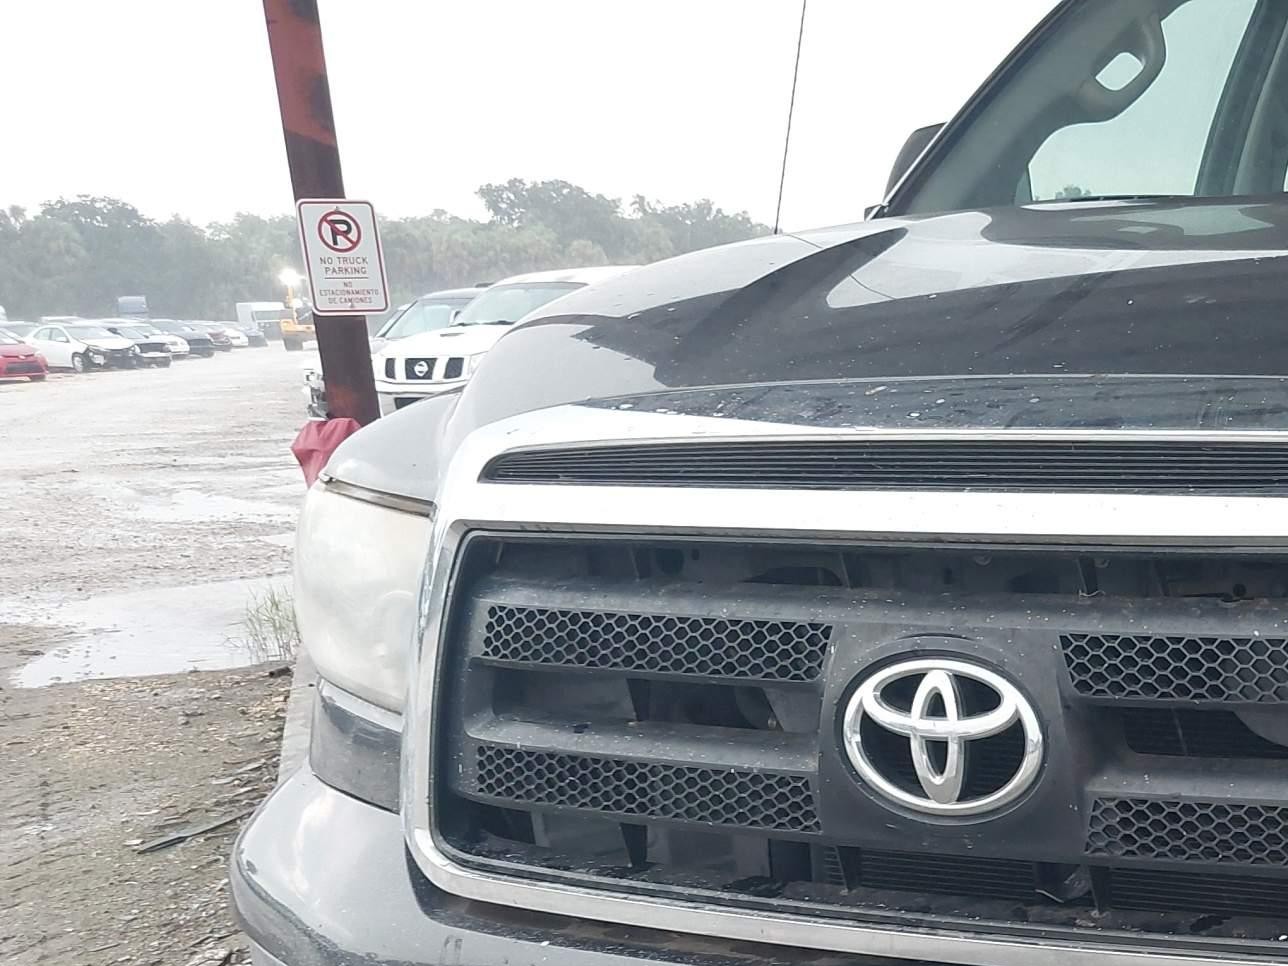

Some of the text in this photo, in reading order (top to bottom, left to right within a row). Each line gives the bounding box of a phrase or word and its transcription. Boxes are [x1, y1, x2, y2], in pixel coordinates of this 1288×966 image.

[319, 257, 369, 265] NO TRUCK
[324, 267, 367, 275] PARKING
